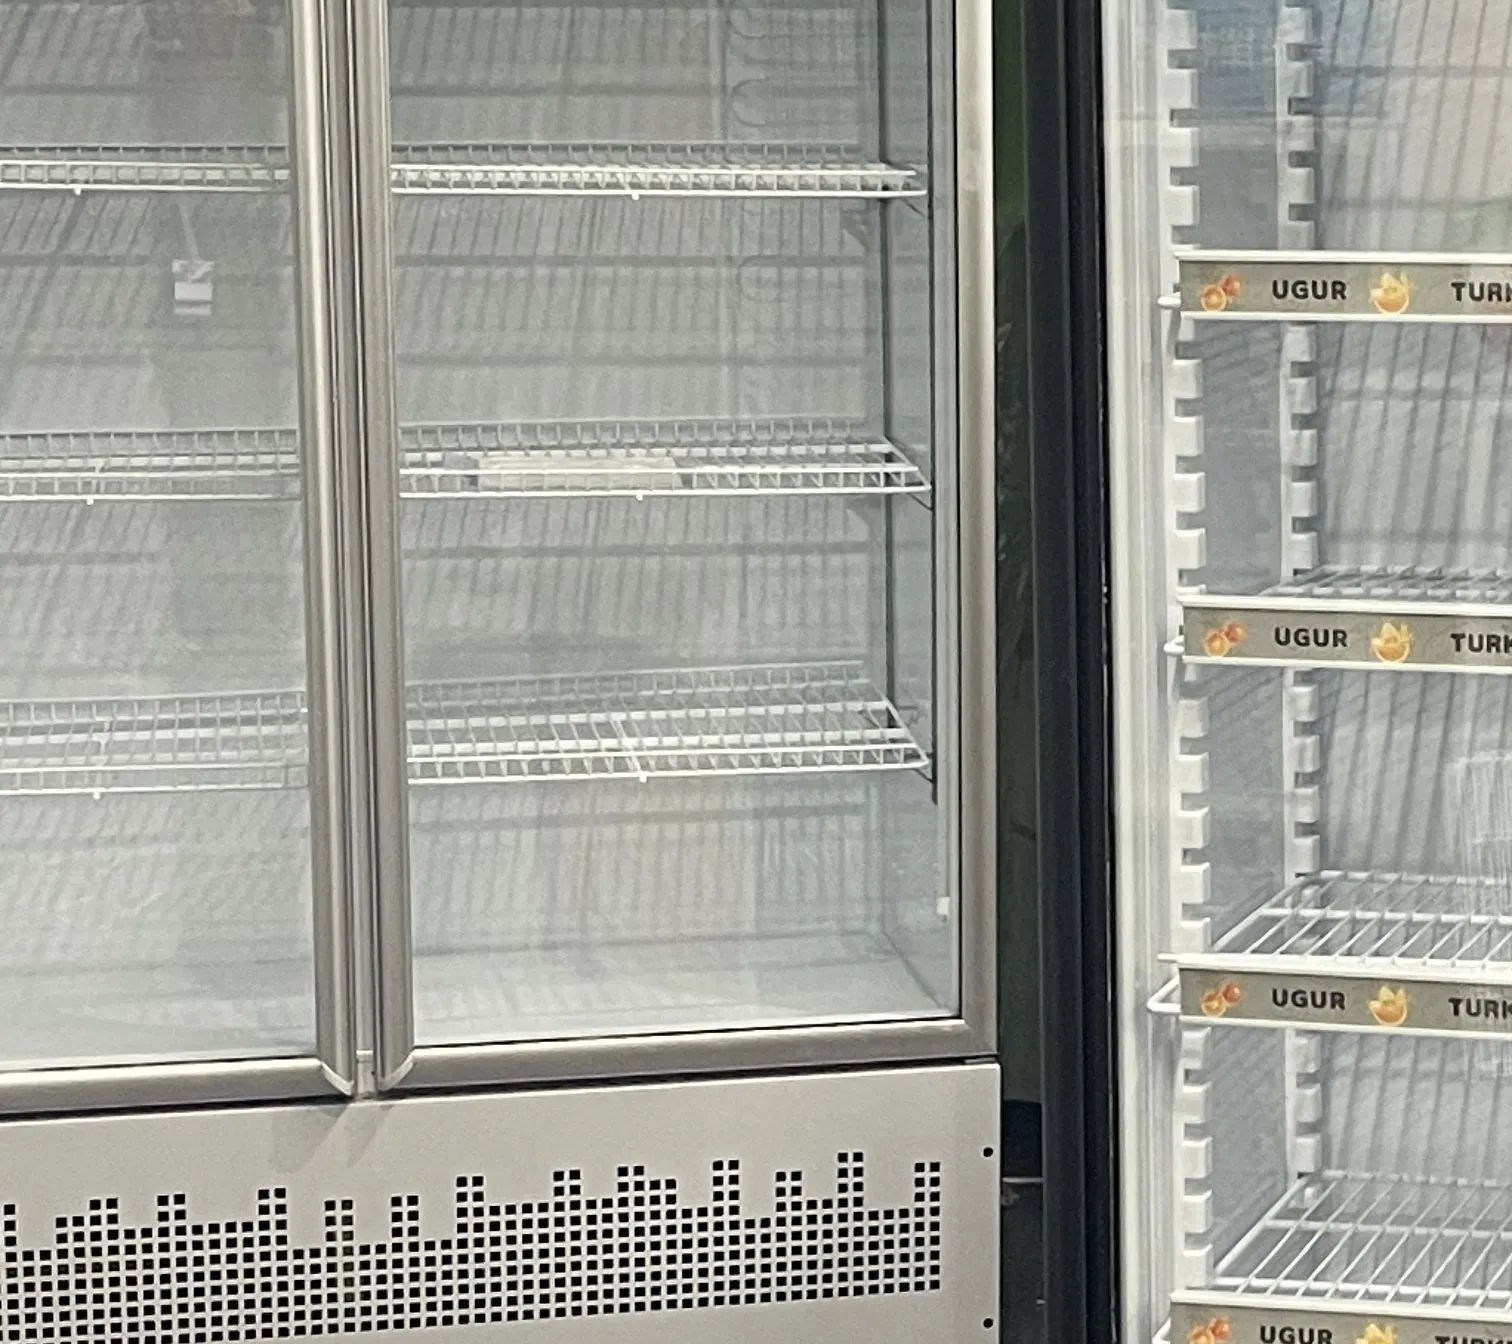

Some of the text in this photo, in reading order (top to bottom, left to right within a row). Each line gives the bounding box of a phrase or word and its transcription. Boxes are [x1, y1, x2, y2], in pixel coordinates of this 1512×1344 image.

[1272, 279, 1347, 300] UGUR
[1274, 627, 1348, 648] UGUR
[1272, 988, 1345, 1011] UGUR
